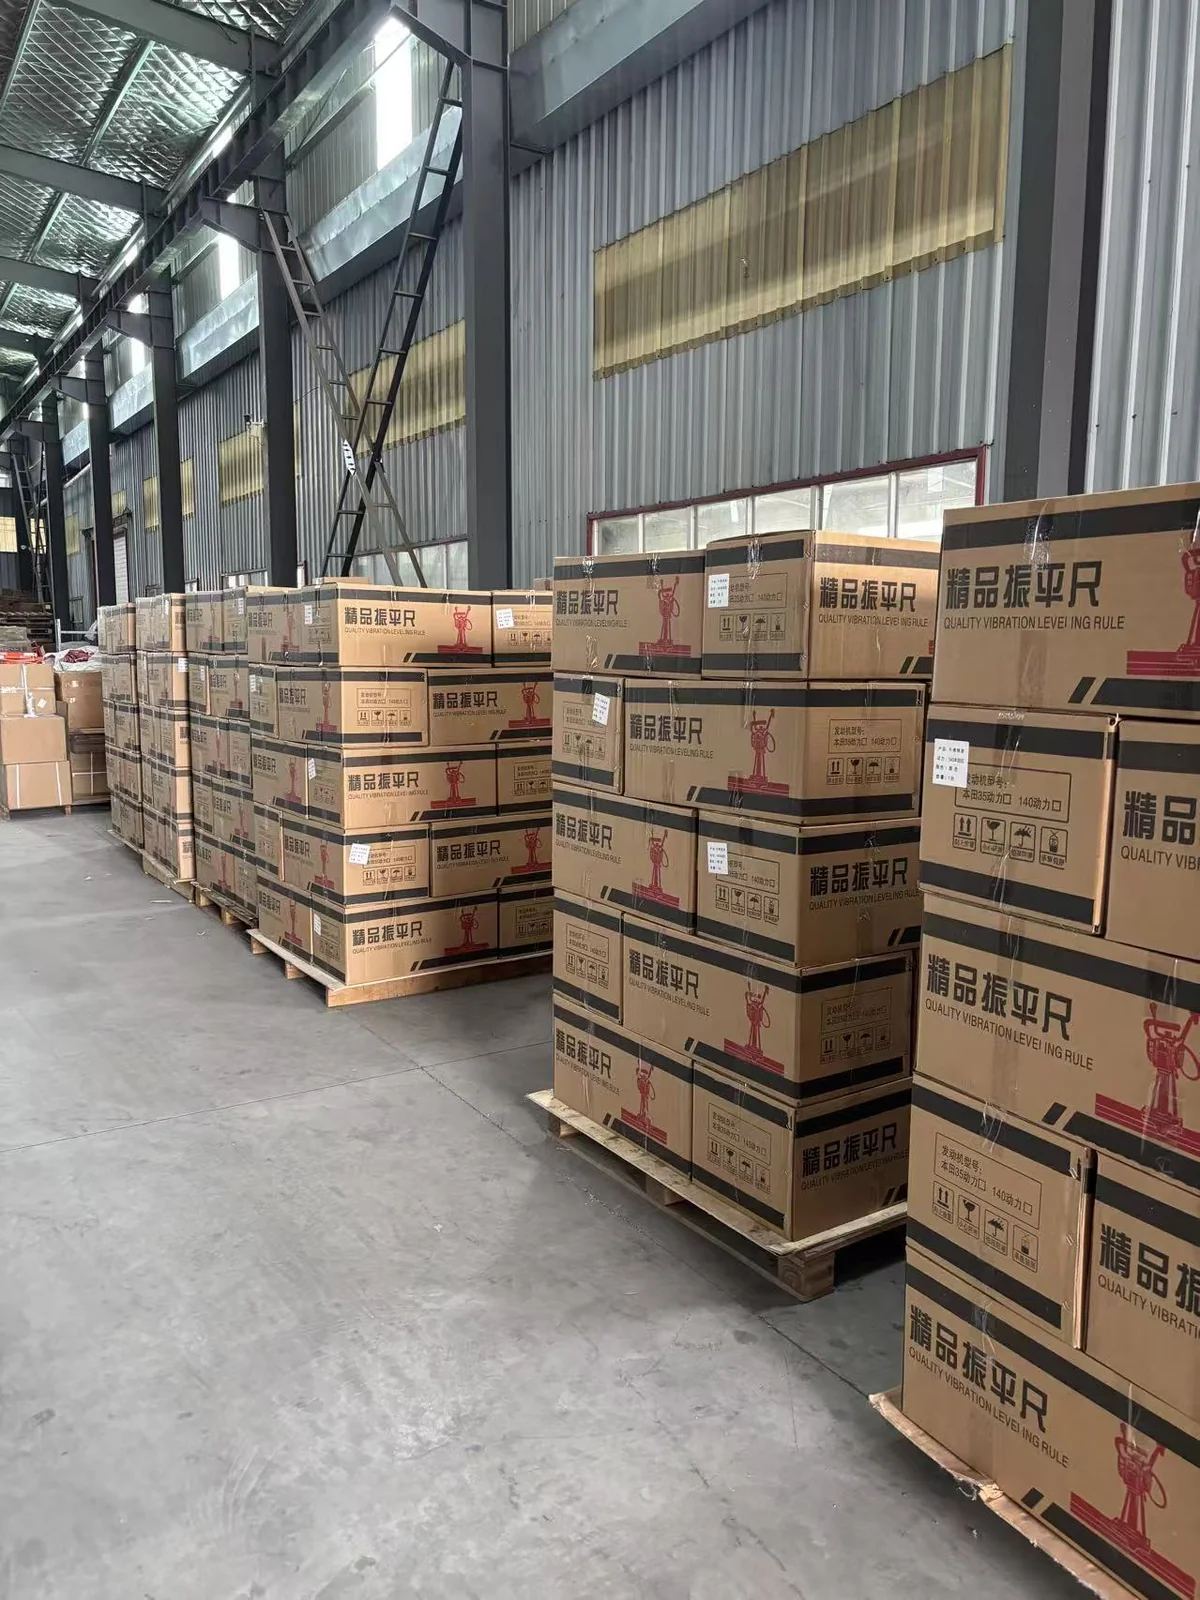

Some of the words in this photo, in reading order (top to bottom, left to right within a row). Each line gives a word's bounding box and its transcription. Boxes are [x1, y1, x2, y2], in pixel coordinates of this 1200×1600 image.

[556, 590, 618, 615] 精品振平尺
[820, 577, 916, 612] 精品振平尺
[946, 561, 1102, 609] 精品振平尺
[345, 607, 415, 627] 精品振平尺
[819, 614, 846, 624] QUALITY
[848, 615, 880, 625] VIBRATION
[913, 617, 928, 628] RULE
[944, 617, 982, 629] QUALITY
[984, 616, 1037, 629] VIBRATION
[1094, 616, 1125, 629] RULE
[433, 691, 498, 709] 精品振平尺
[630, 713, 702, 744] 精品振平尺
[700, 749, 714, 759] RULE
[348, 772, 419, 791] 精品振平尺
[556, 813, 612, 850] 精品振平尺
[1123, 791, 1197, 845] 精品
[437, 840, 500, 862] 精品振平尺
[1121, 846, 1172, 866] QUALITY
[810, 857, 908, 896] 精品振平尺
[809, 899, 837, 911] QUALITY
[839, 895, 874, 907] VIBRATION
[353, 921, 422, 946] 精品振平尺
[629, 949, 698, 999] 精品振平尺
[927, 953, 1073, 1041] 精品振平尺
[926, 998, 961, 1021] QUALITY
[962, 1010, 1012, 1041] VIBRATION
[1065, 1049, 1093, 1071] RULE
[556, 1028, 611, 1079] 精品振平尺
[803, 1122, 897, 1177] 精品振平尺
[1098, 1274, 1147, 1310] QUALITY
[910, 1304, 1048, 1433] 精品振平尺
[909, 1346, 944, 1379] QUALITY
[945, 1371, 992, 1414] VIBRATION
[1042, 1441, 1069, 1469] RULE
